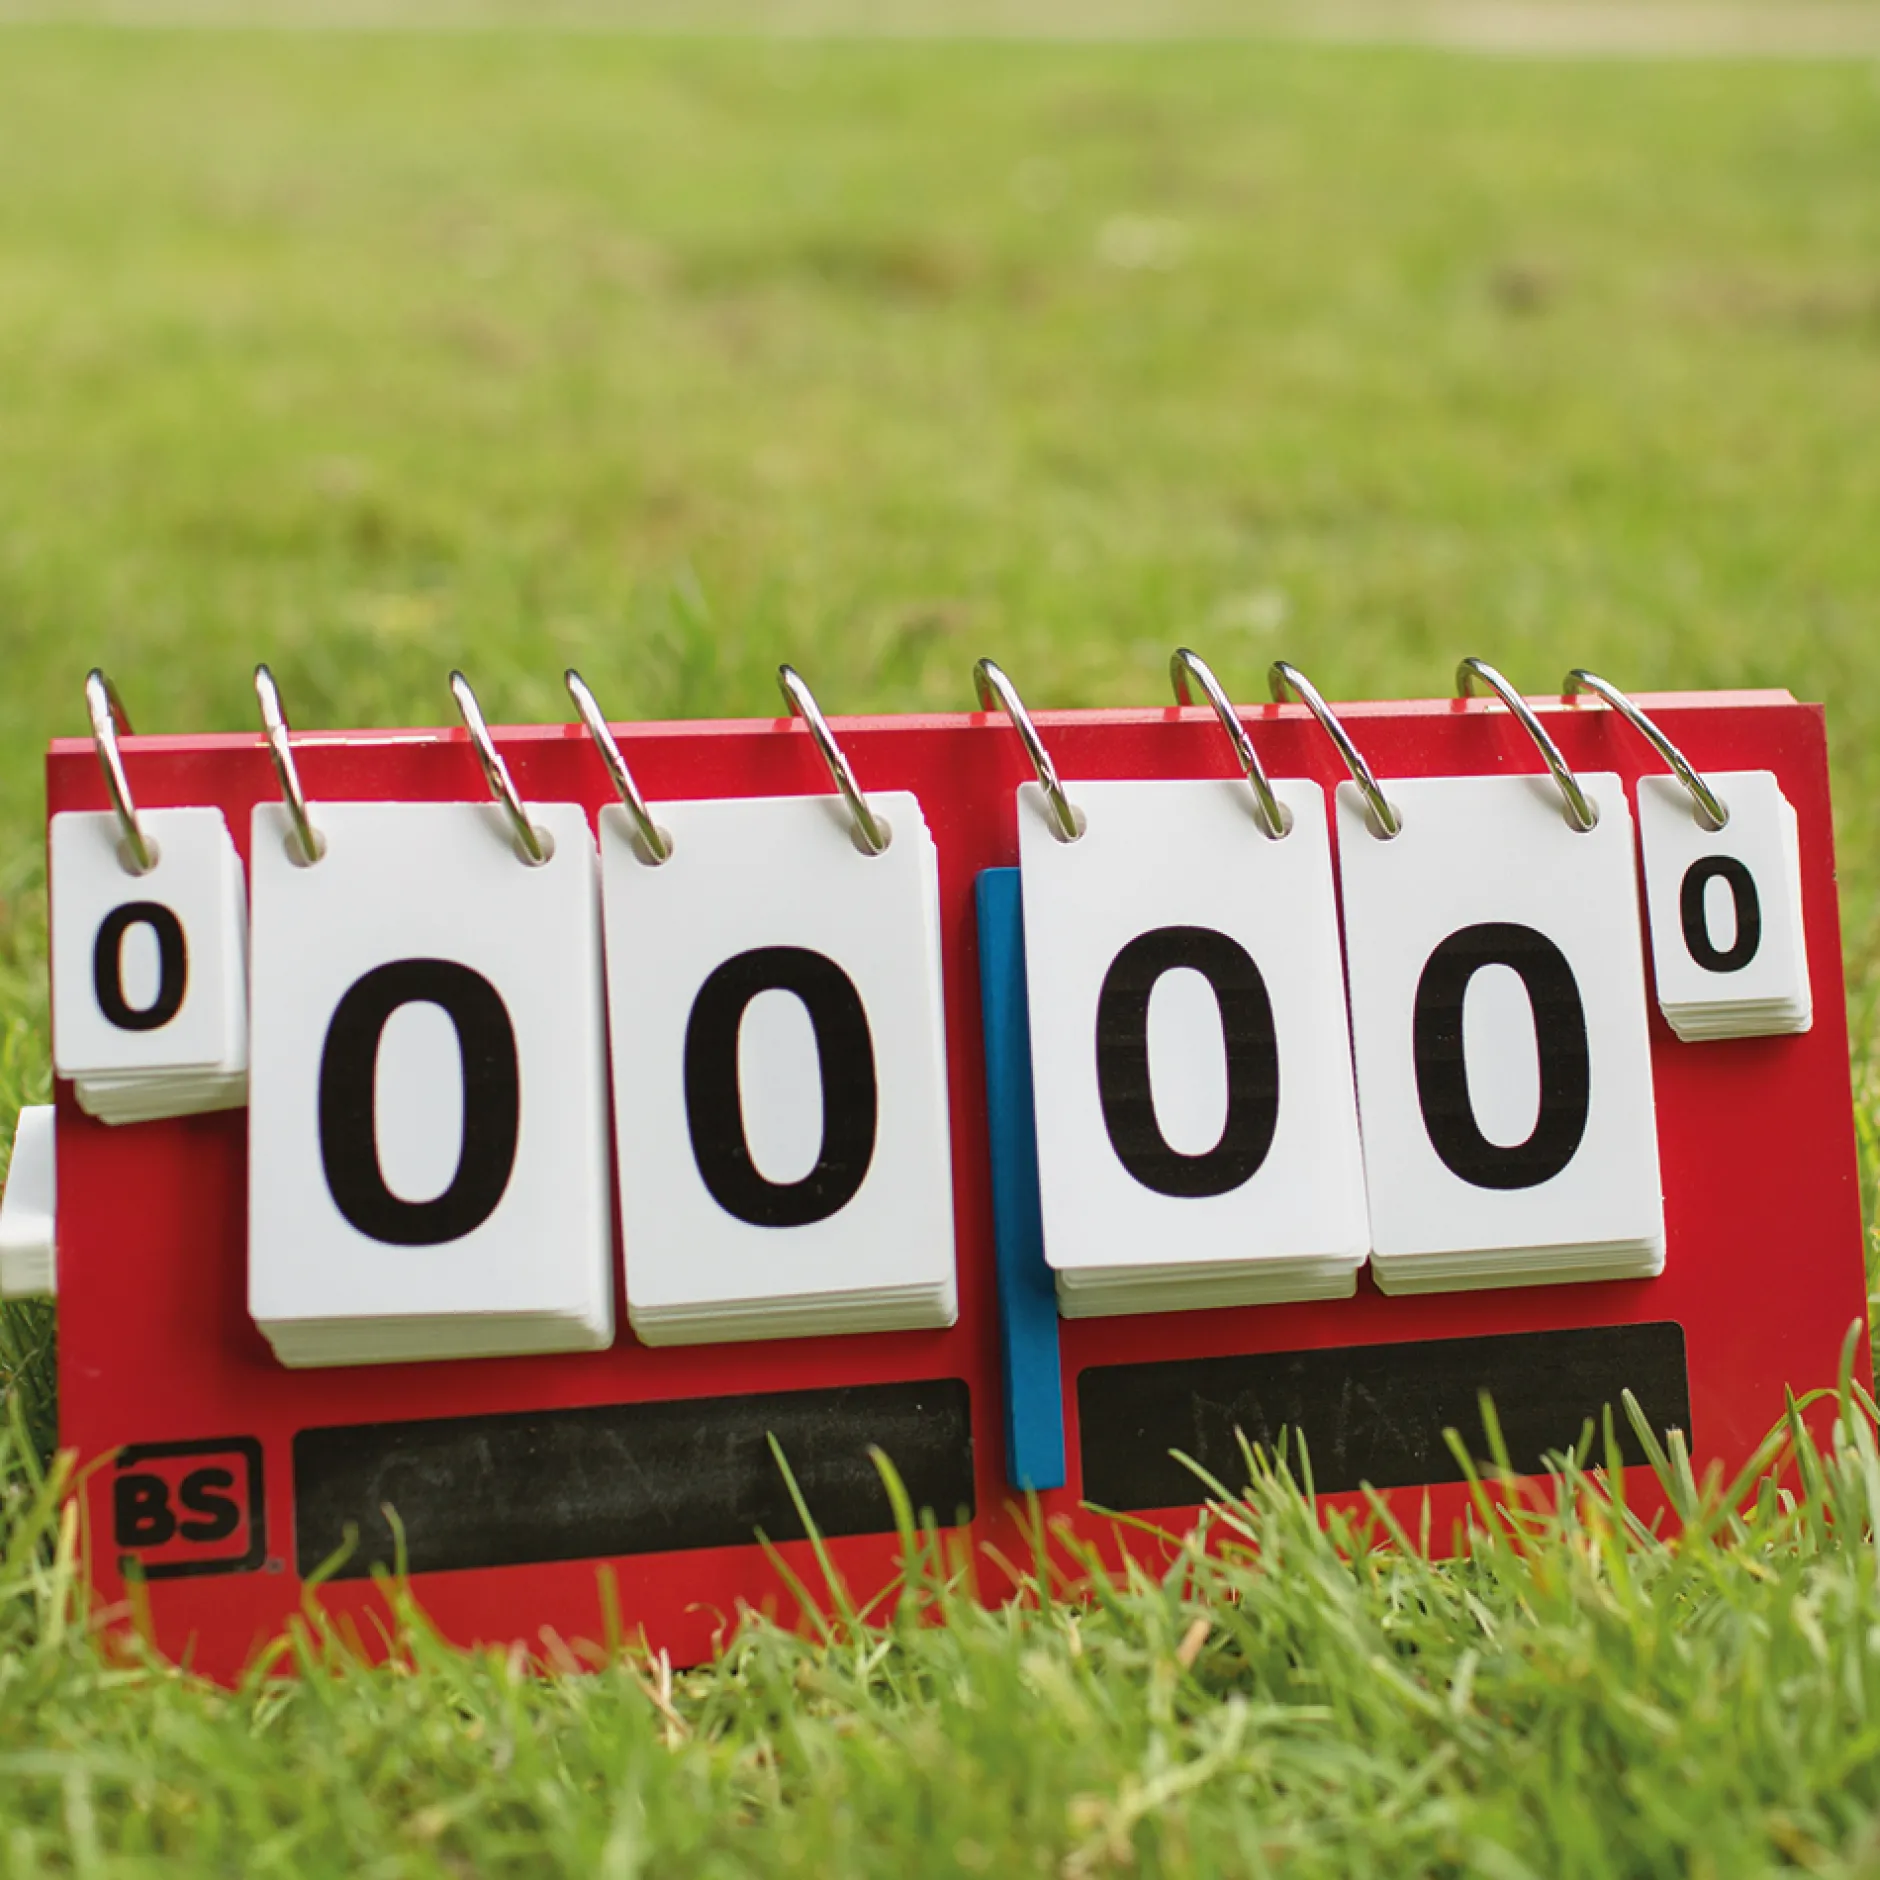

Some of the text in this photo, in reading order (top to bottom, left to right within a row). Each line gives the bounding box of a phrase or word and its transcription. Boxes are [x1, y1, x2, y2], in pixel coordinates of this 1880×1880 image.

[94, 901, 187, 1032] 0
[1679, 856, 1761, 973] 0
[318, 945, 877, 1246] 0 0
[1095, 922, 1590, 1198] 0 0
[114, 1467, 240, 1547] BS
